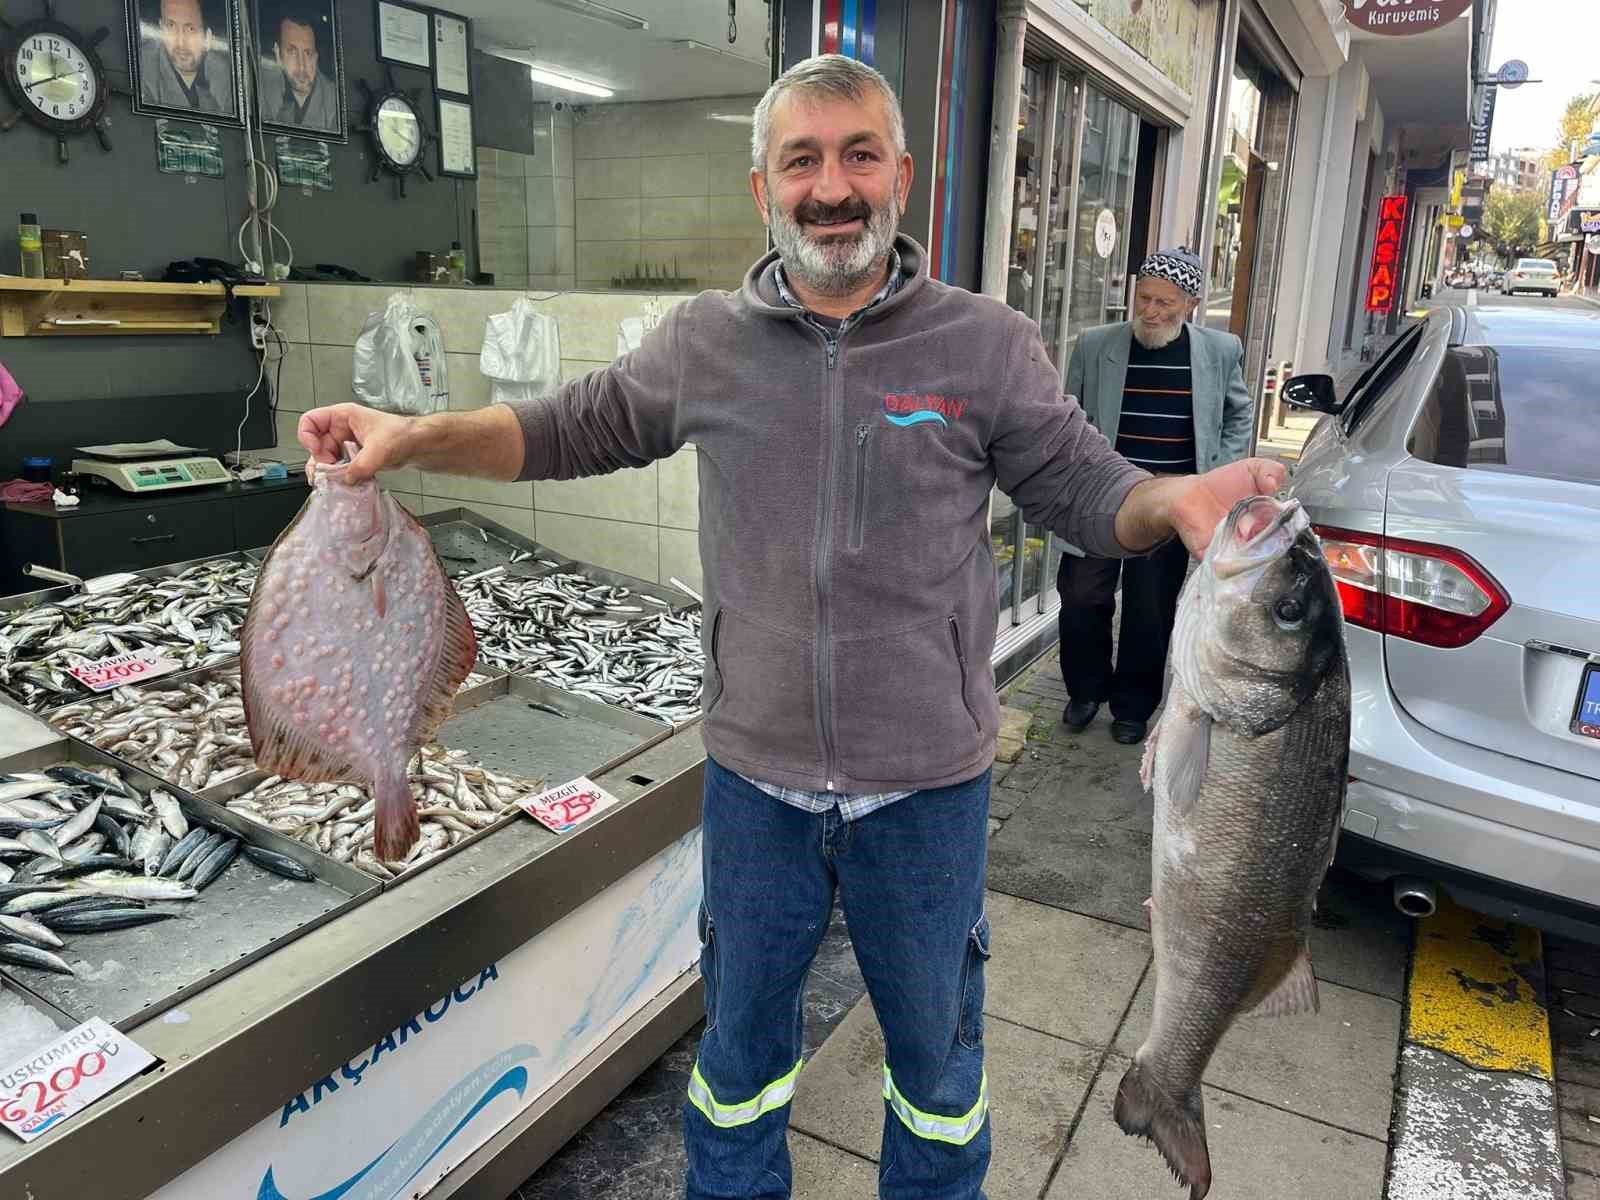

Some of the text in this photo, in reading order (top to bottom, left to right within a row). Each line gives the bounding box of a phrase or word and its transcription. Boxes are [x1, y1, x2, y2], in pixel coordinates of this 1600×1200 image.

[1368, 6, 1440, 25] Kuruyemiş
[32, 39, 43, 51] 11
[48, 39, 61, 52] 12
[22, 48, 33, 60] 10
[67, 48, 72, 59] 1
[20, 63, 26, 75] 9
[78, 61, 85, 72] 2
[83, 79, 88, 91] 3
[37, 96, 44, 107] 7
[80, 94, 85, 104] 4
[53, 104, 59, 116] 6
[69, 103, 75, 115] 5
[1371, 198, 1405, 306] KASAP
[2, 1027, 97, 1089] USKUMRU
